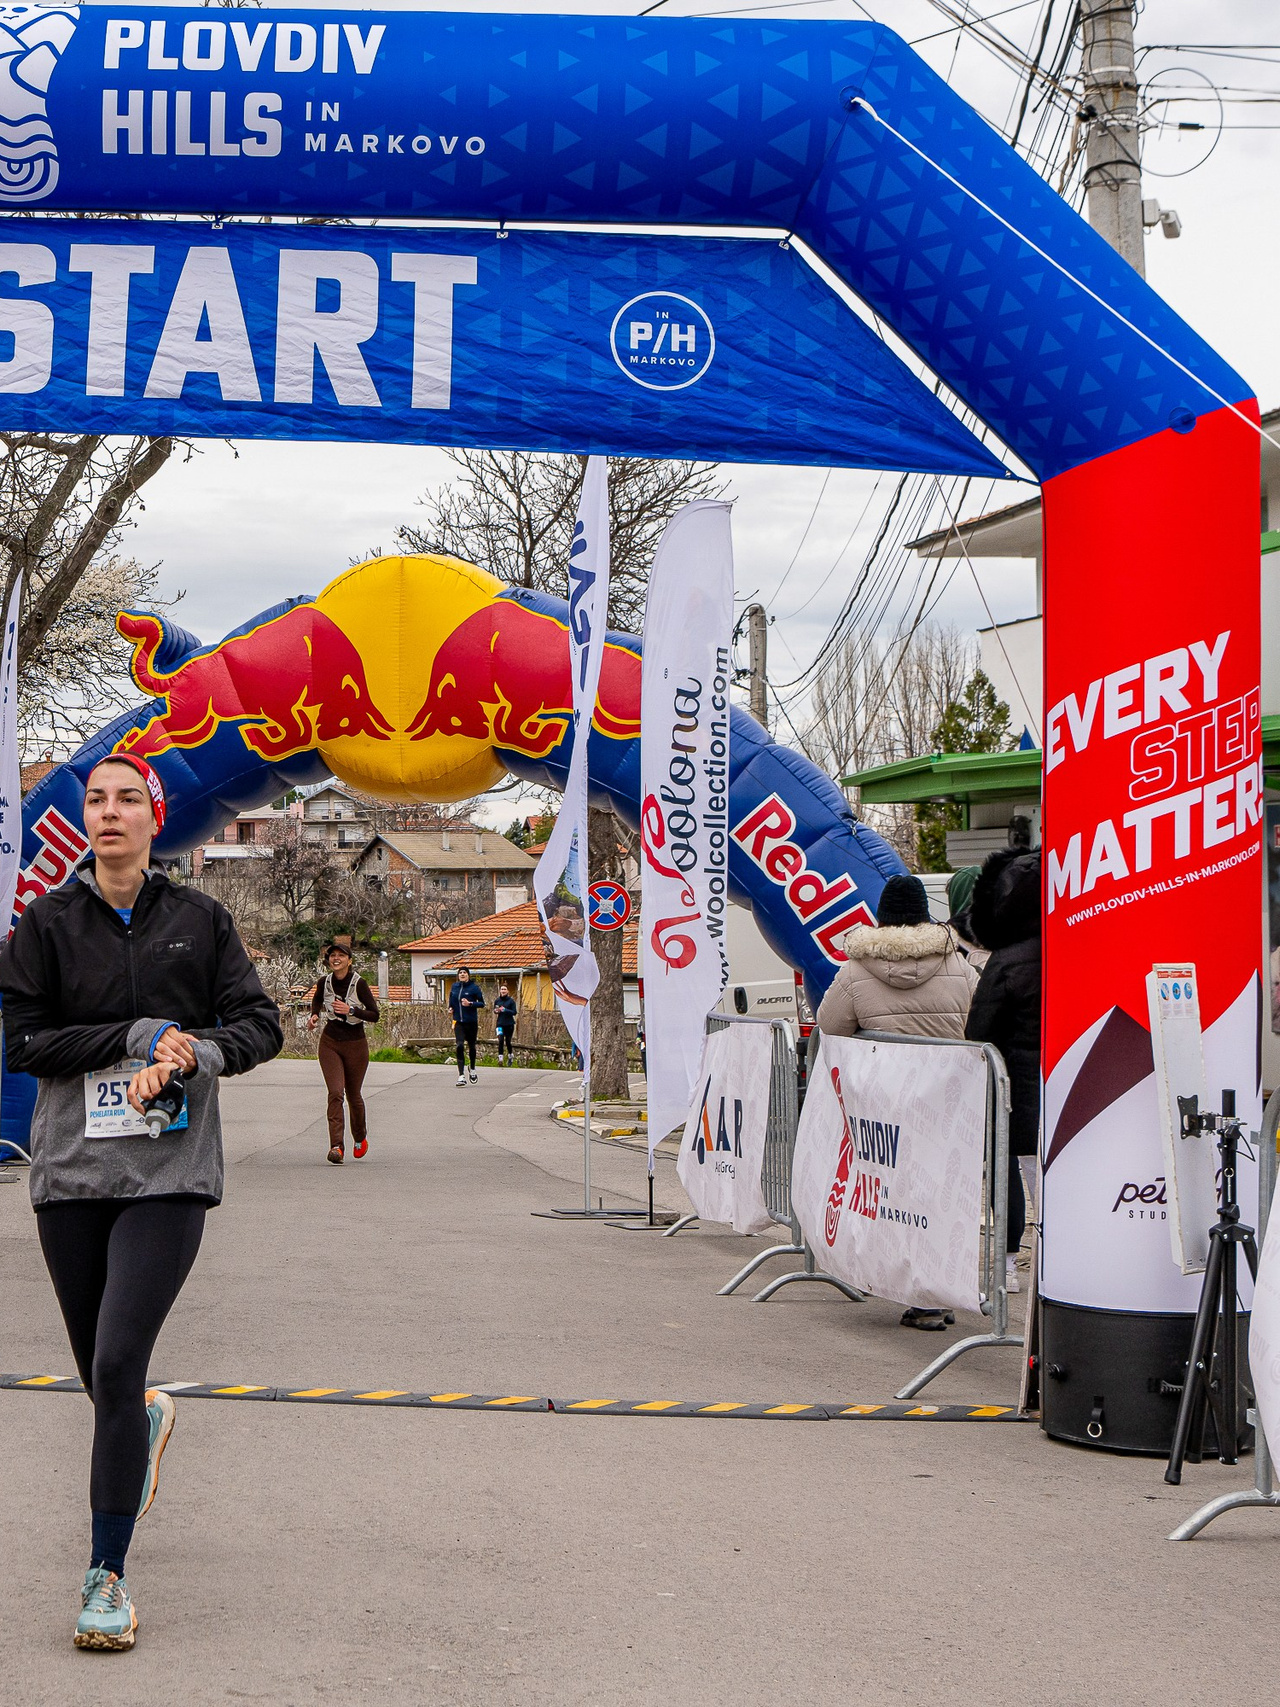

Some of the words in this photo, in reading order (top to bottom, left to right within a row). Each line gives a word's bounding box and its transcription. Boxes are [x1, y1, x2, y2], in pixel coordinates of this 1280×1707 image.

[103, 20, 387, 74] PLOVDIV
[102, 90, 282, 157] HILLS
[305, 102, 340, 122] IN
[304, 133, 486, 156] MARKOVO
[656, 311, 669, 319] IN
[629, 321, 696, 354] P/H
[629, 355, 696, 367] MARKOVO
[1046, 630, 1231, 776] EVERY
[1129, 685, 1260, 801] STEP
[732, 795, 853, 921] Red
[1066, 841, 1260, 927] WWW.PLOVDIV-HILLS-IN-MARKOVO.COM
[756, 995, 793, 1006] DUCATO
[90, 1110, 113, 1119] PCHELATA
[114, 1109, 126, 1117] RUN
[881, 1185, 889, 1200] IN
[880, 1205, 928, 1230] MARKOVO
[1128, 1210, 1167, 1219] STUD
